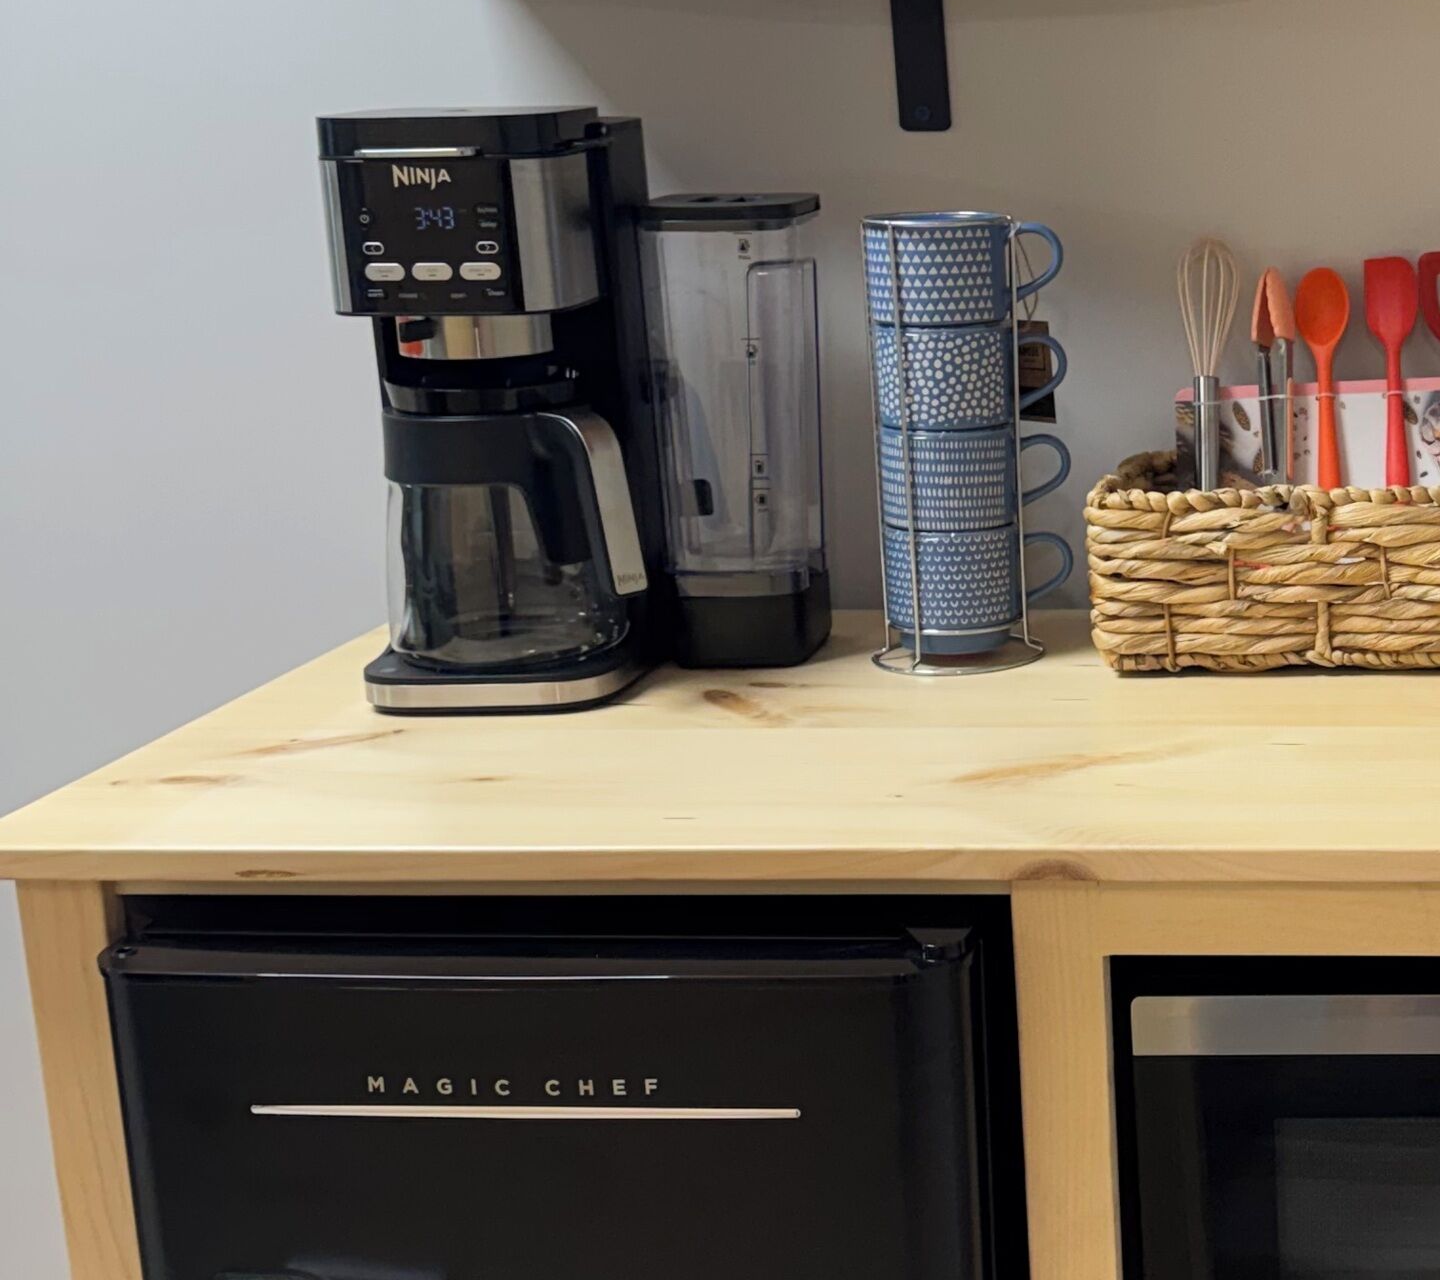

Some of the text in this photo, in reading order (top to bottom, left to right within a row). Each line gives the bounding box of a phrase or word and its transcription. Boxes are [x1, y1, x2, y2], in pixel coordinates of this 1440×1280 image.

[392, 164, 451, 190] NINJA
[367, 1075, 658, 1097] MAGIC CHEF
